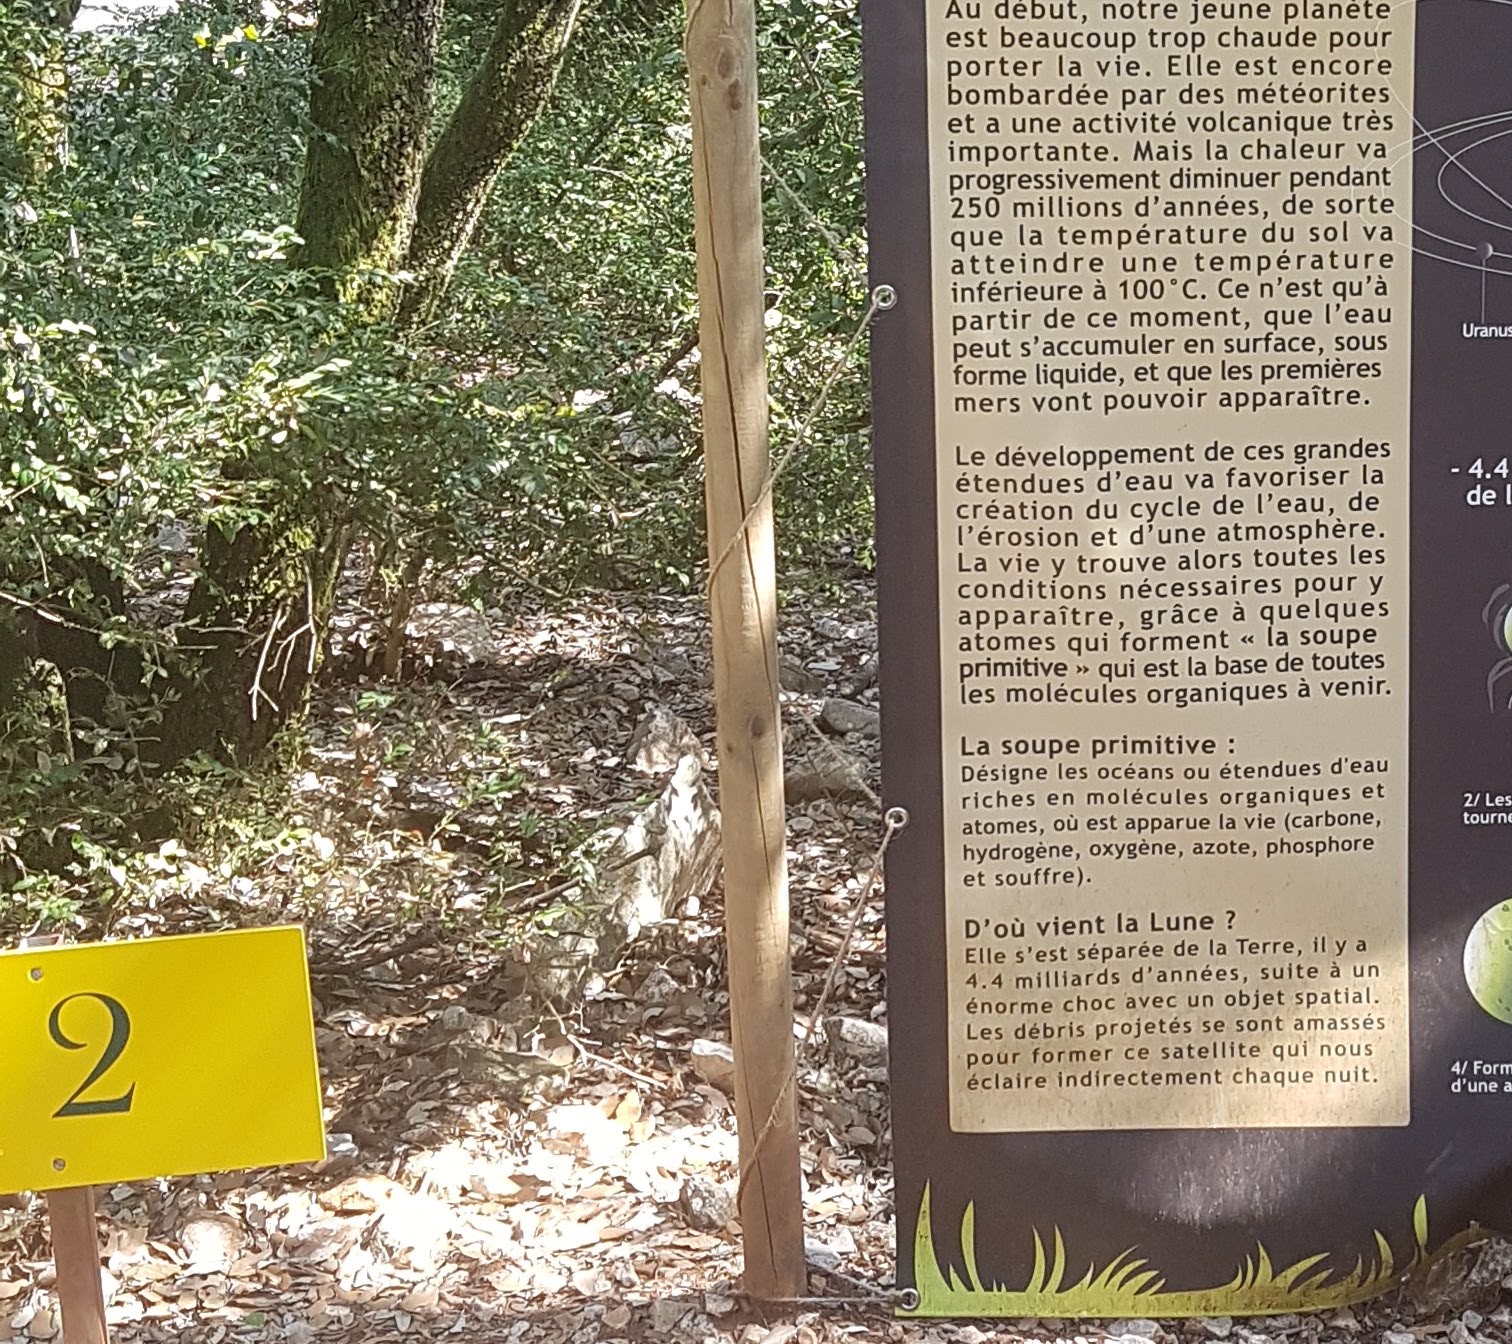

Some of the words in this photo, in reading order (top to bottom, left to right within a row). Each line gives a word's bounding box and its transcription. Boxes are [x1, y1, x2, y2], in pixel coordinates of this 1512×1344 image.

[947, 82, 1109, 106] bombardée
[1121, 88, 1167, 111] par
[1178, 82, 1225, 105] des
[1237, 81, 1390, 105] météorites
[950, 196, 1001, 219] 250
[1012, 195, 1123, 218] millions
[1134, 194, 1269, 221] d'années,
[1281, 193, 1314, 216] de
[1325, 194, 1395, 215] sorte
[955, 445, 986, 467] Le
[995, 443, 1195, 472] développement
[1204, 440, 1235, 462] de
[1243, 444, 1285, 461] ces
[1293, 437, 1391, 465] grandes
[1468, 457, 1509, 480] 4.4
[1466, 483, 1497, 506] de
[957, 578, 1107, 600] conditions
[1120, 574, 1282, 600] nécessaires
[1294, 575, 1358, 599] pour
[1369, 575, 1384, 597] y
[962, 789, 1036, 810] riches
[1046, 792, 1075, 806] en
[1086, 787, 1209, 806] molécules
[1219, 785, 1351, 809] organiques
[1361, 782, 1385, 799] et
[1463, 792, 1481, 808] 2/
[1485, 792, 1512, 807] Les
[963, 841, 1081, 865] hydrogène,
[1089, 838, 1184, 860] oxygène,
[1192, 839, 1257, 858] azote,
[1266, 835, 1375, 859] phosphore
[966, 1023, 1004, 1041] Les
[1013, 1021, 1085, 1040] débris
[1095, 1016, 1192, 1041] projetés
[1202, 1019, 1226, 1034] se
[1235, 1015, 1284, 1033] sont
[1293, 1012, 1386, 1032] amassés
[48, 992, 136, 1119] 2
[1450, 1060, 1468, 1075] 4/
[966, 1072, 1047, 1091] éclaire
[1057, 1068, 1223, 1088] indirectement
[1232, 1066, 1314, 1089] chaque
[1324, 1065, 1378, 1083] nuit.
[1450, 1077, 1499, 1093] d'une
